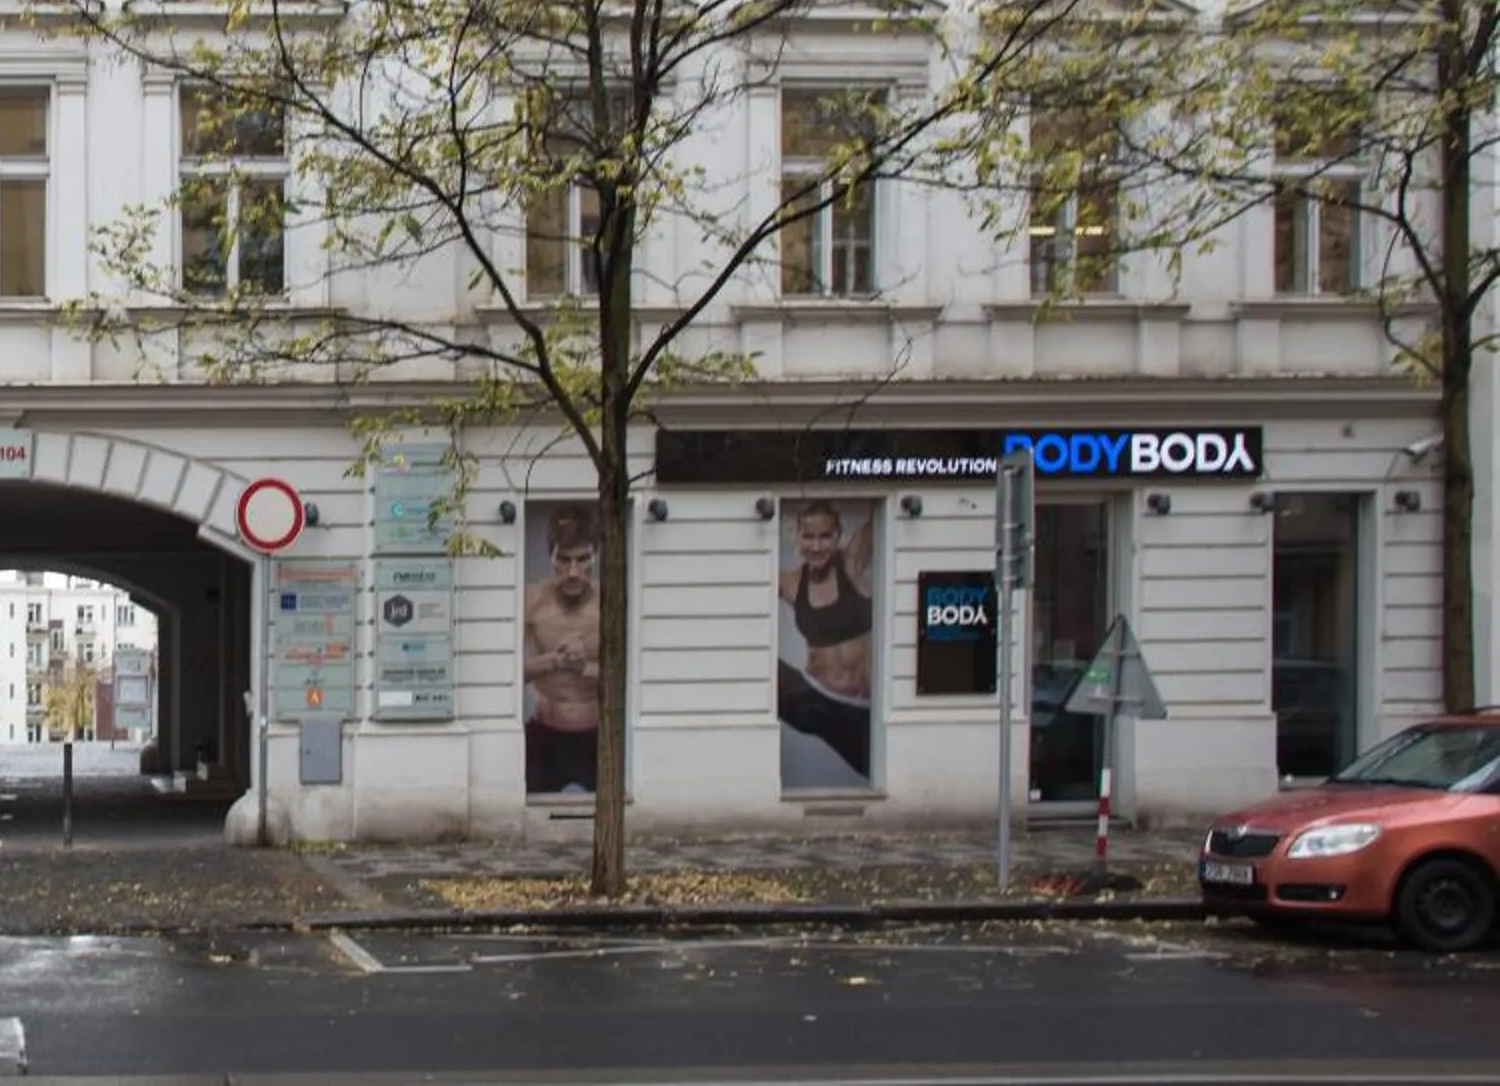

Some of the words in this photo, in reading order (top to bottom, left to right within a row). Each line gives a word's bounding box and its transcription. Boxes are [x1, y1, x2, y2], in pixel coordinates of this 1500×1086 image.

[825, 458, 893, 476] FITNESS
[895, 457, 997, 474] REVOLUTION
[927, 588, 988, 604] BODY
[927, 604, 988, 626] BODY
